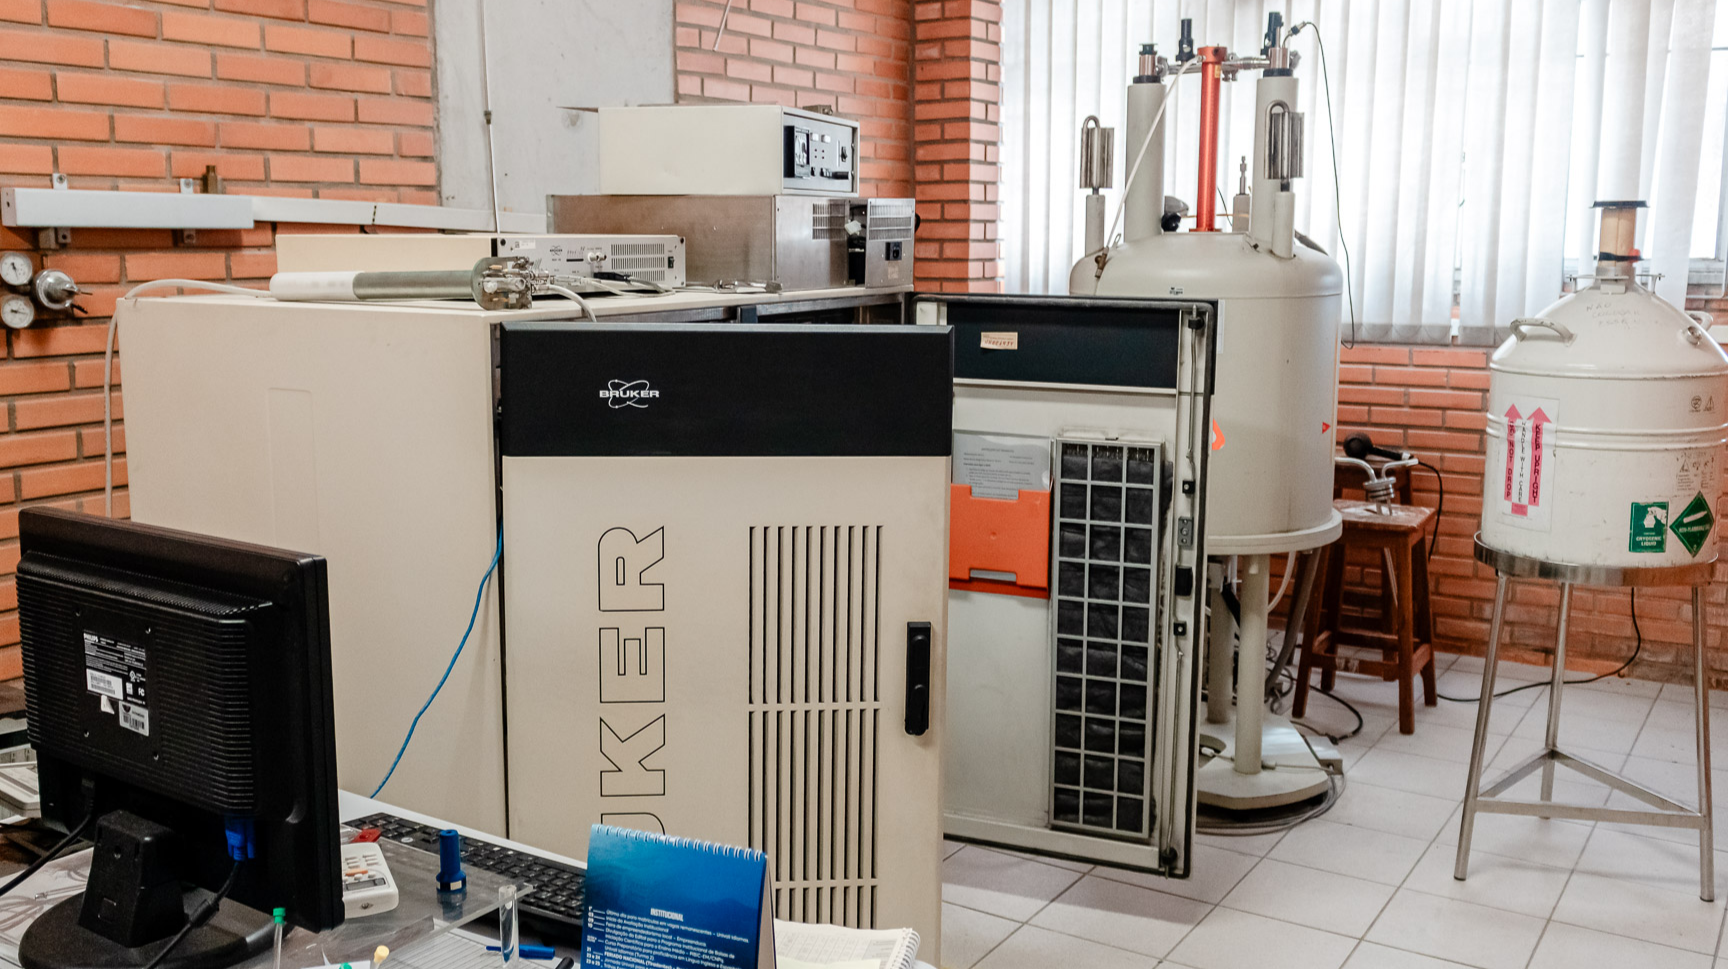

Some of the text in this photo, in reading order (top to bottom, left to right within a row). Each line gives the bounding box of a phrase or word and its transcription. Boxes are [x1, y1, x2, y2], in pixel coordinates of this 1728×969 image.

[1532, 455, 1541, 503] UPRIGHT
[650, 908, 683, 921] INSTITUCIONAL
[622, 925, 661, 938] empreendedorismo
[644, 924, 669, 933] Institucional
[680, 925, 712, 935] remanescentes
[661, 940, 681, 948] Programa
[623, 956, 645, 964] NACIONAL
